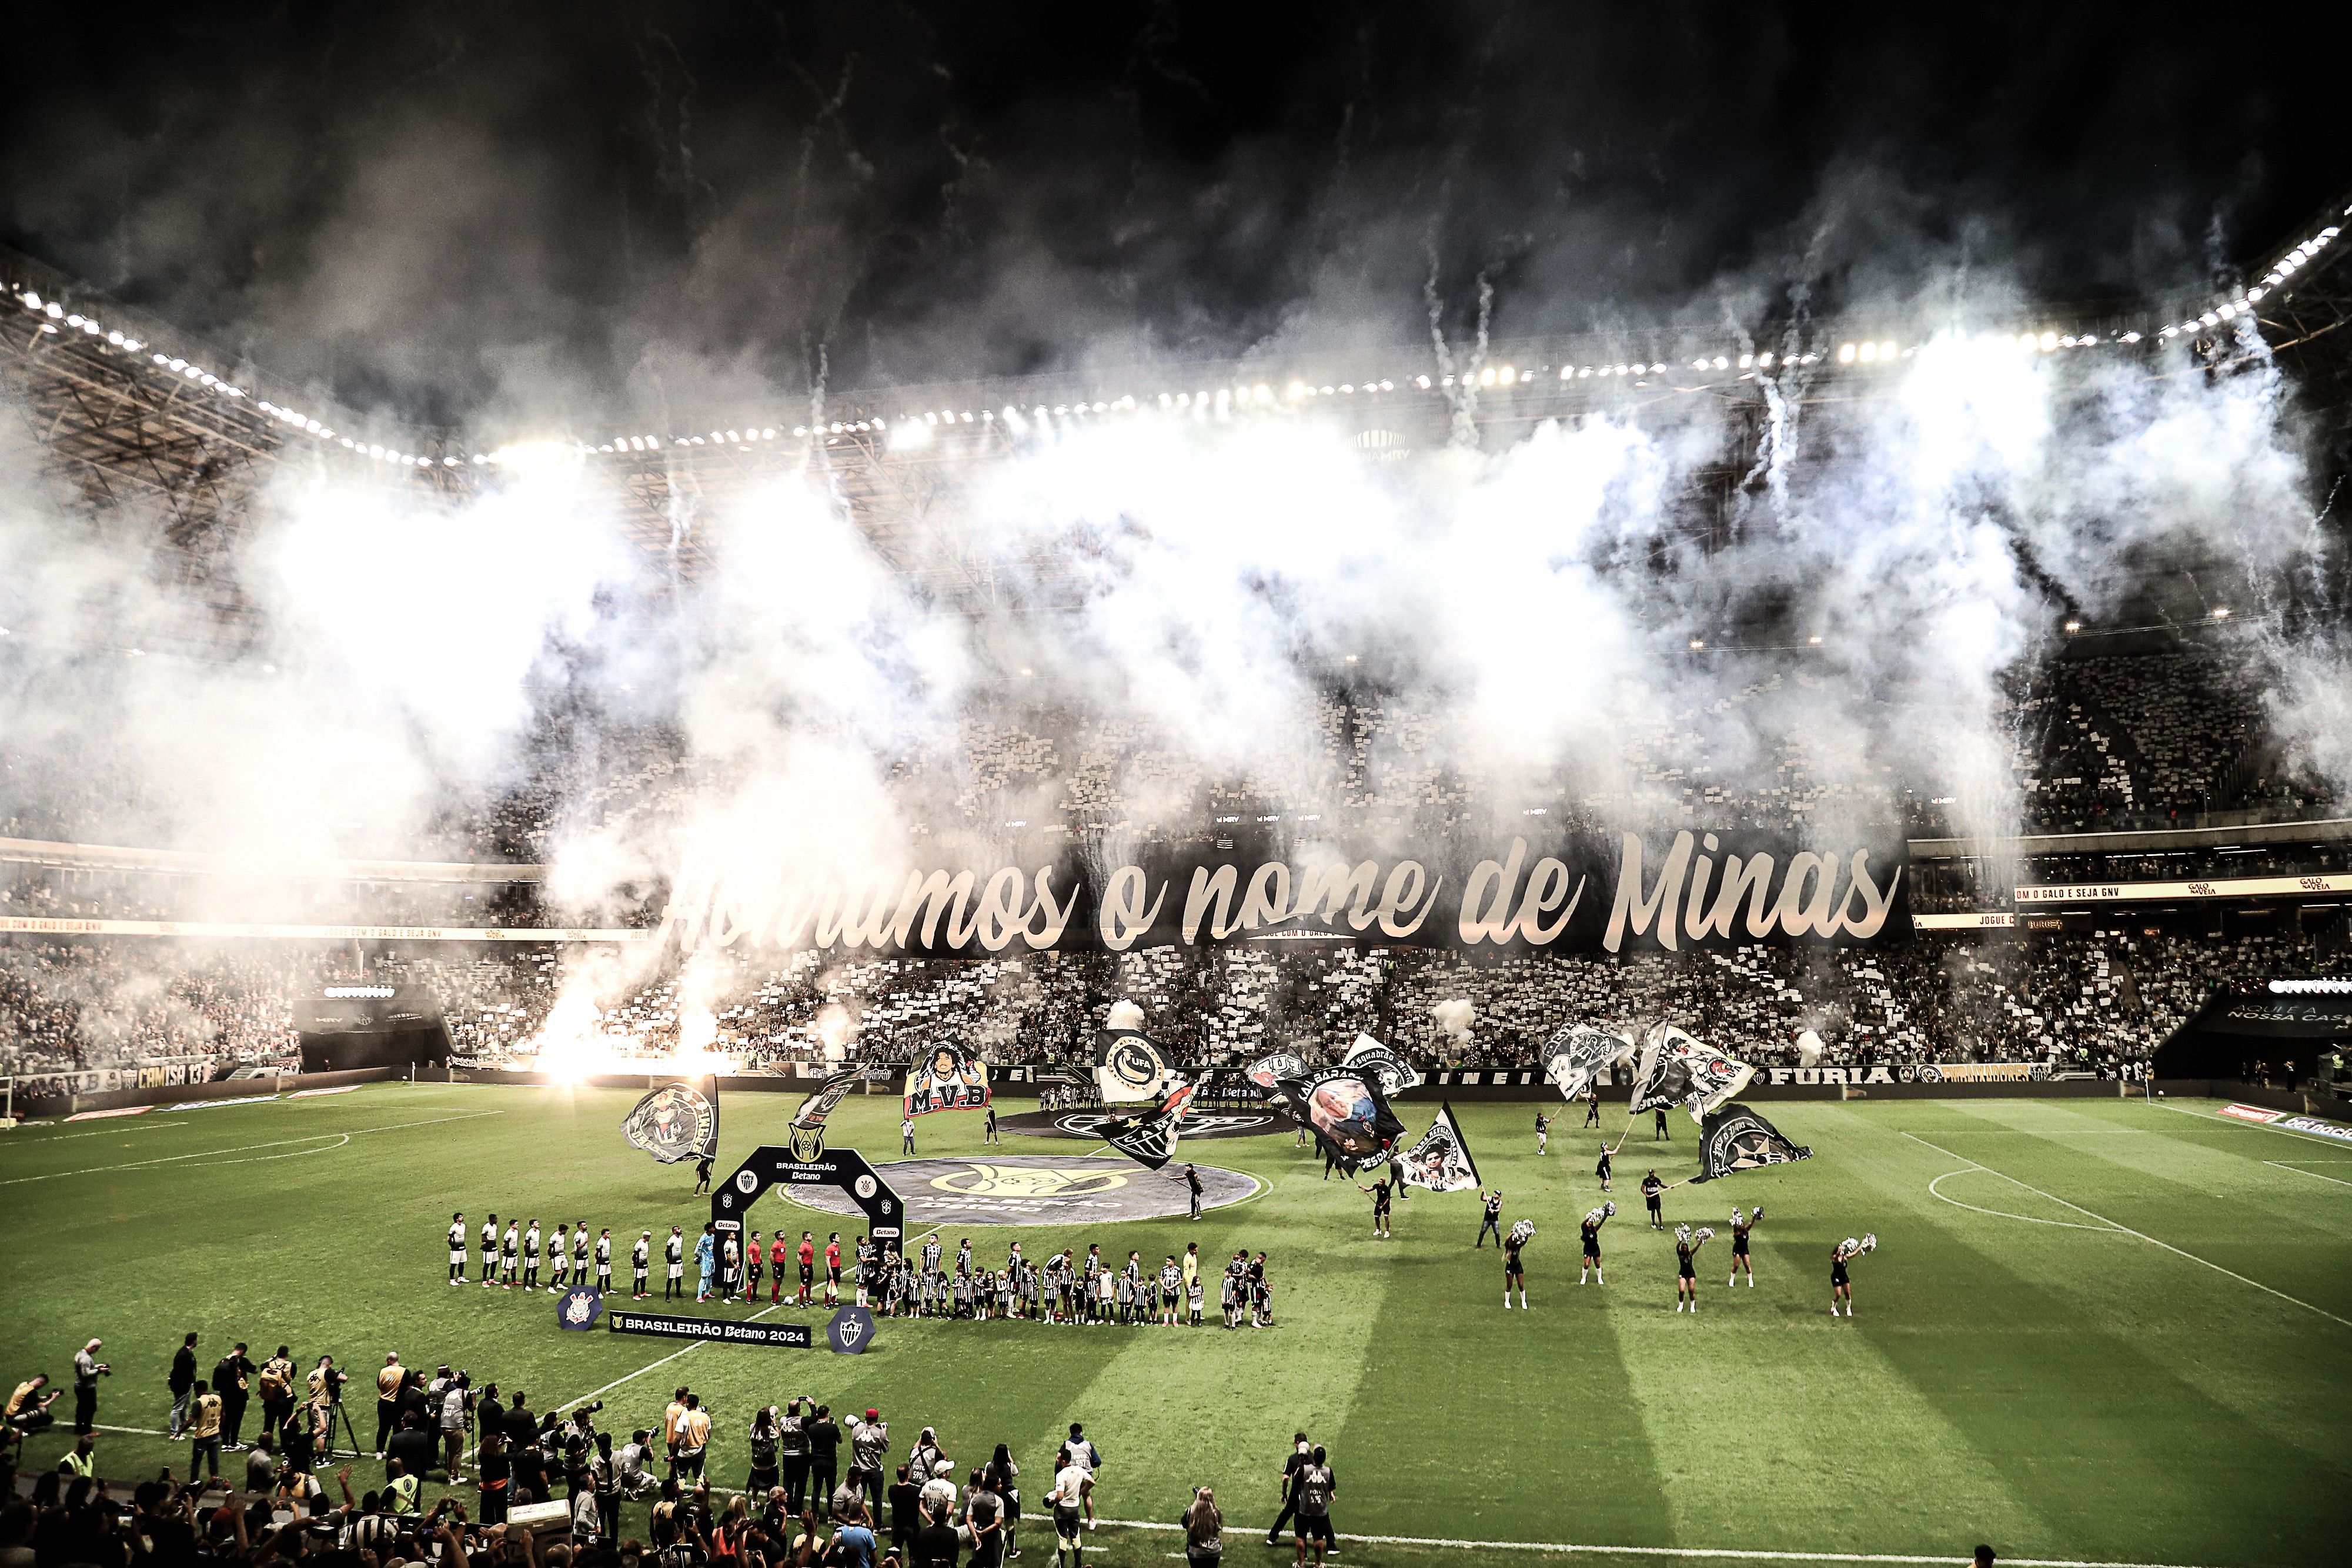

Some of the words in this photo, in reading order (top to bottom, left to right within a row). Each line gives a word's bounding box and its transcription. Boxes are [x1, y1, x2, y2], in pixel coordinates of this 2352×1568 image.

[1100, 865, 1168, 951] o
[1181, 860, 1442, 945] nome
[1459, 837, 1585, 945] de
[1603, 830, 1901, 952] Minas
[2034, 890, 2039, 898] O
[2043, 890, 2064, 898] GALO
[2068, 889, 2072, 897] E
[2076, 888, 2098, 897] SEJA
[2102, 888, 2119, 896] GNV
[1980, 916, 2005, 924] JOGUE
[2227, 1011, 2294, 1021] NOSSA
[1131, 1057, 1152, 1069] UFA
[138, 1064, 185, 1089] CAMISA
[188, 1064, 201, 1085] 13
[1769, 1066, 1895, 1085] FURIA
[1124, 1119, 1170, 1143] CAM
[776, 1162, 837, 1171] BRASILEIRÃO
[791, 1172, 821, 1181] Betano
[625, 1318, 722, 1336] BRASILEIRÃO
[724, 1325, 766, 1339] Betano
[769, 1330, 805, 1343] 2024
